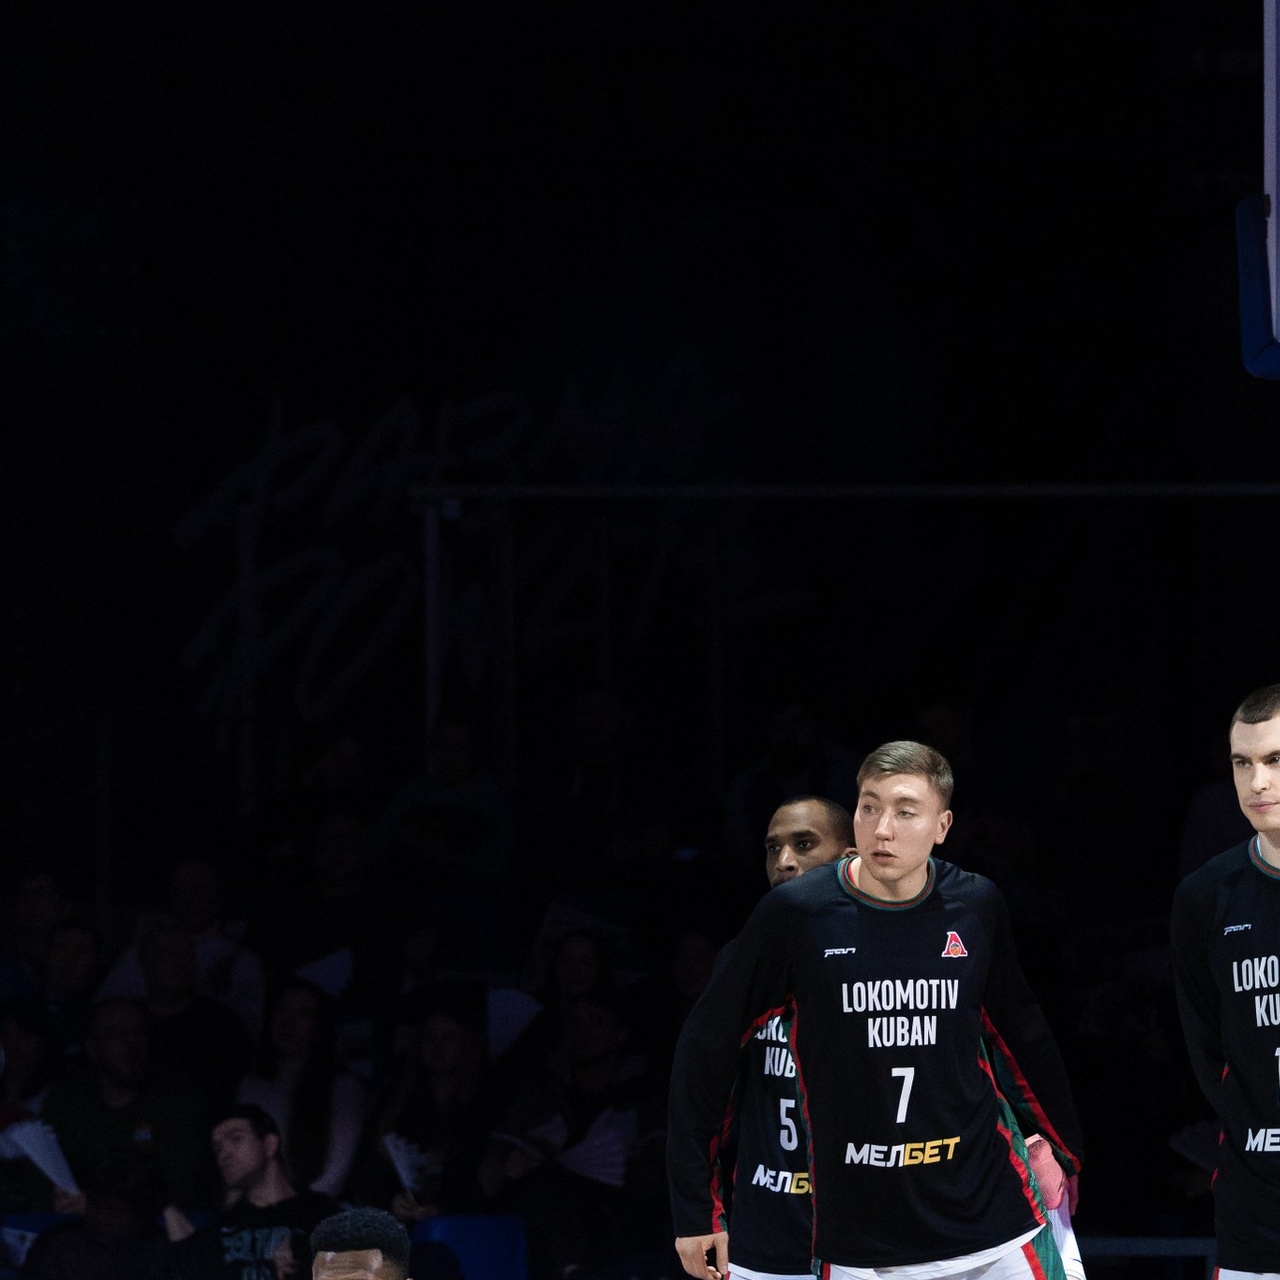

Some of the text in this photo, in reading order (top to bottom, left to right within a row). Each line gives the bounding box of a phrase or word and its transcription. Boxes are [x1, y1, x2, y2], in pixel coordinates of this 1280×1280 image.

[841, 979, 959, 1013] LOKOMOTIV
[867, 1015, 937, 1048] KUBAN
[764, 1046, 797, 1078] KUB
[891, 1066, 915, 1123] 7
[779, 1098, 799, 1151] 5
[844, 1136, 961, 1167] МЕЛБЕТ
